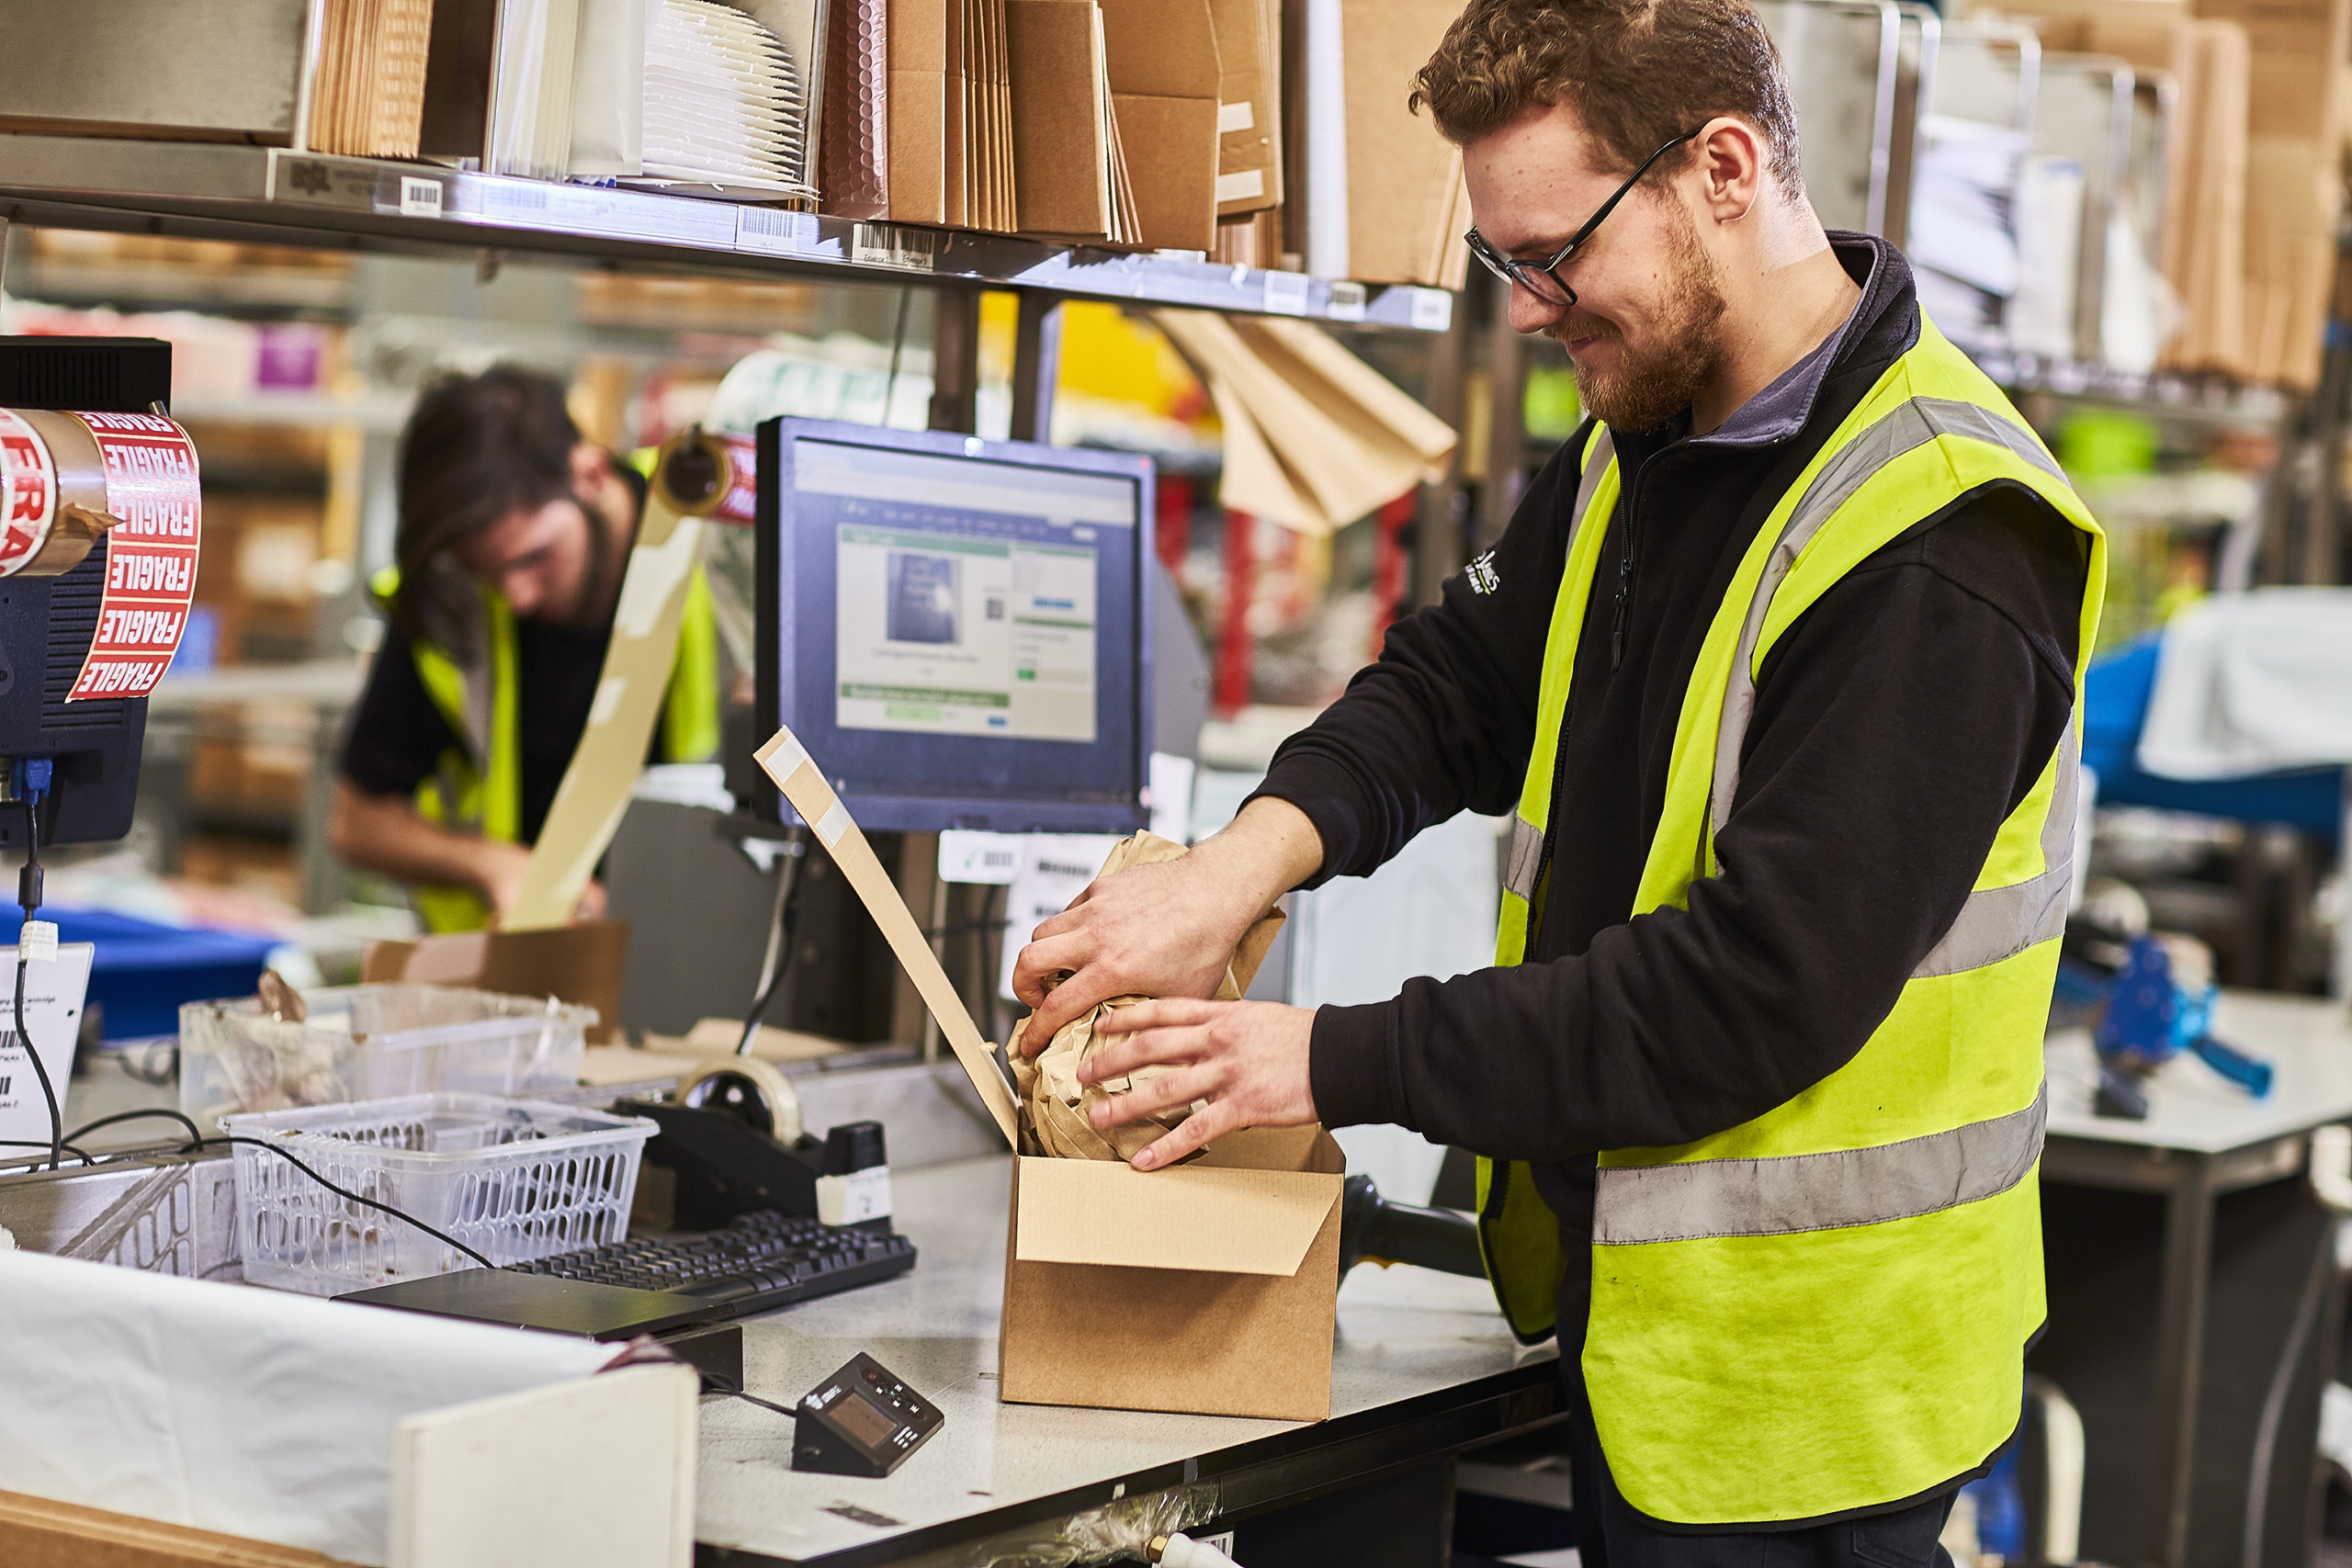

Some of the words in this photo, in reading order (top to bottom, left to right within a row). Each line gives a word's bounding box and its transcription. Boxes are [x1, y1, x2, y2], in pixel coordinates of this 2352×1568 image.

[74, 411, 175, 433] FRAGILE
[103, 445, 192, 481] FRAGILE
[113, 498, 194, 537] FRAGILE
[109, 554, 192, 592] FRAGILE
[98, 610, 183, 644] FRAGILE
[76, 662, 164, 693] FRAGILE
